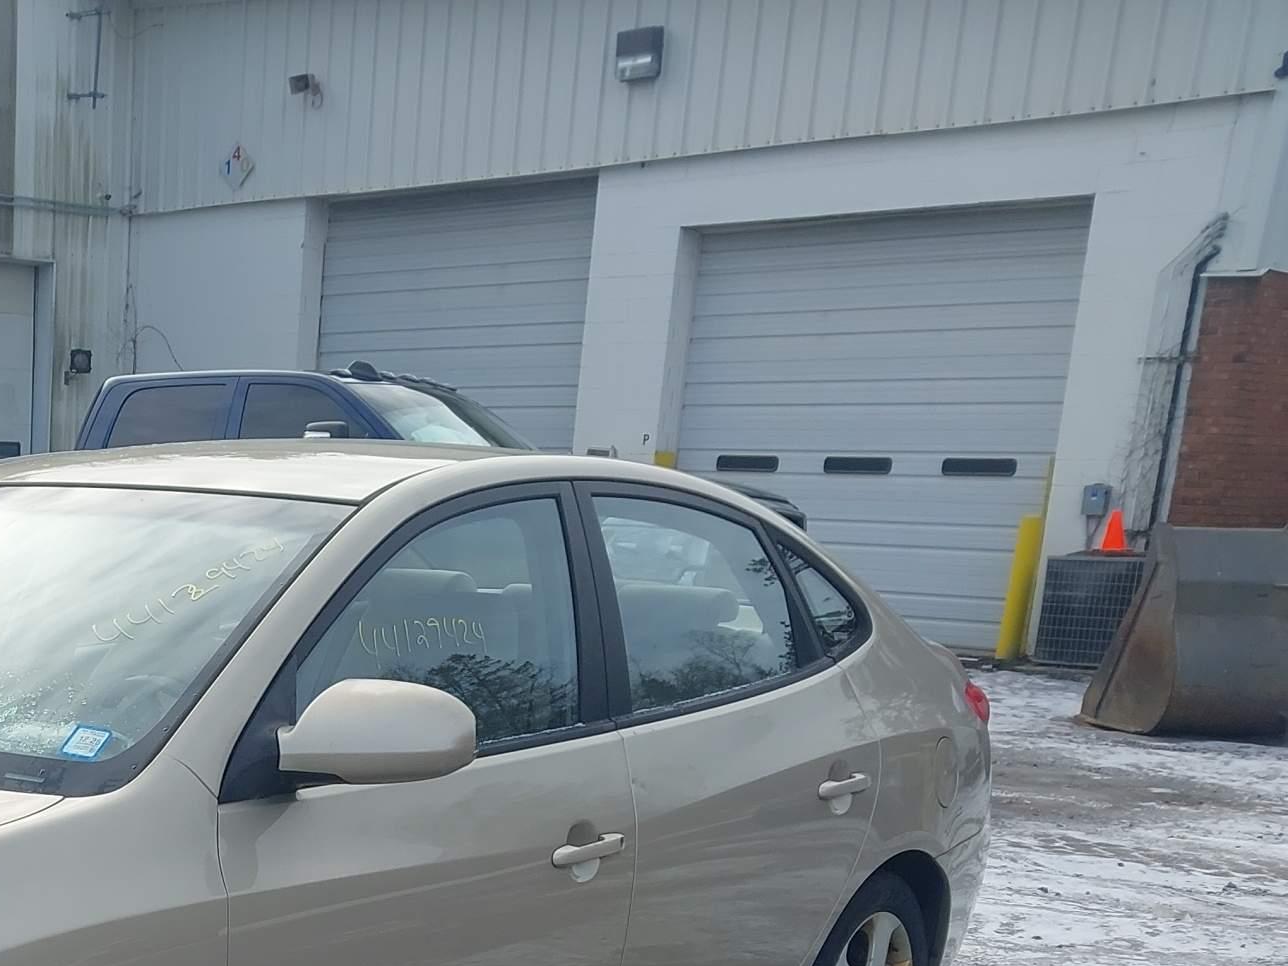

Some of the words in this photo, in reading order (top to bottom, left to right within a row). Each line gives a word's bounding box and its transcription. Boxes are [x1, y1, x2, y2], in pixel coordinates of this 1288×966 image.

[232, 145, 241, 160] 4
[225, 160, 231, 175] 1
[642, 434, 650, 445] P
[358, 616, 488, 669] 44129424
